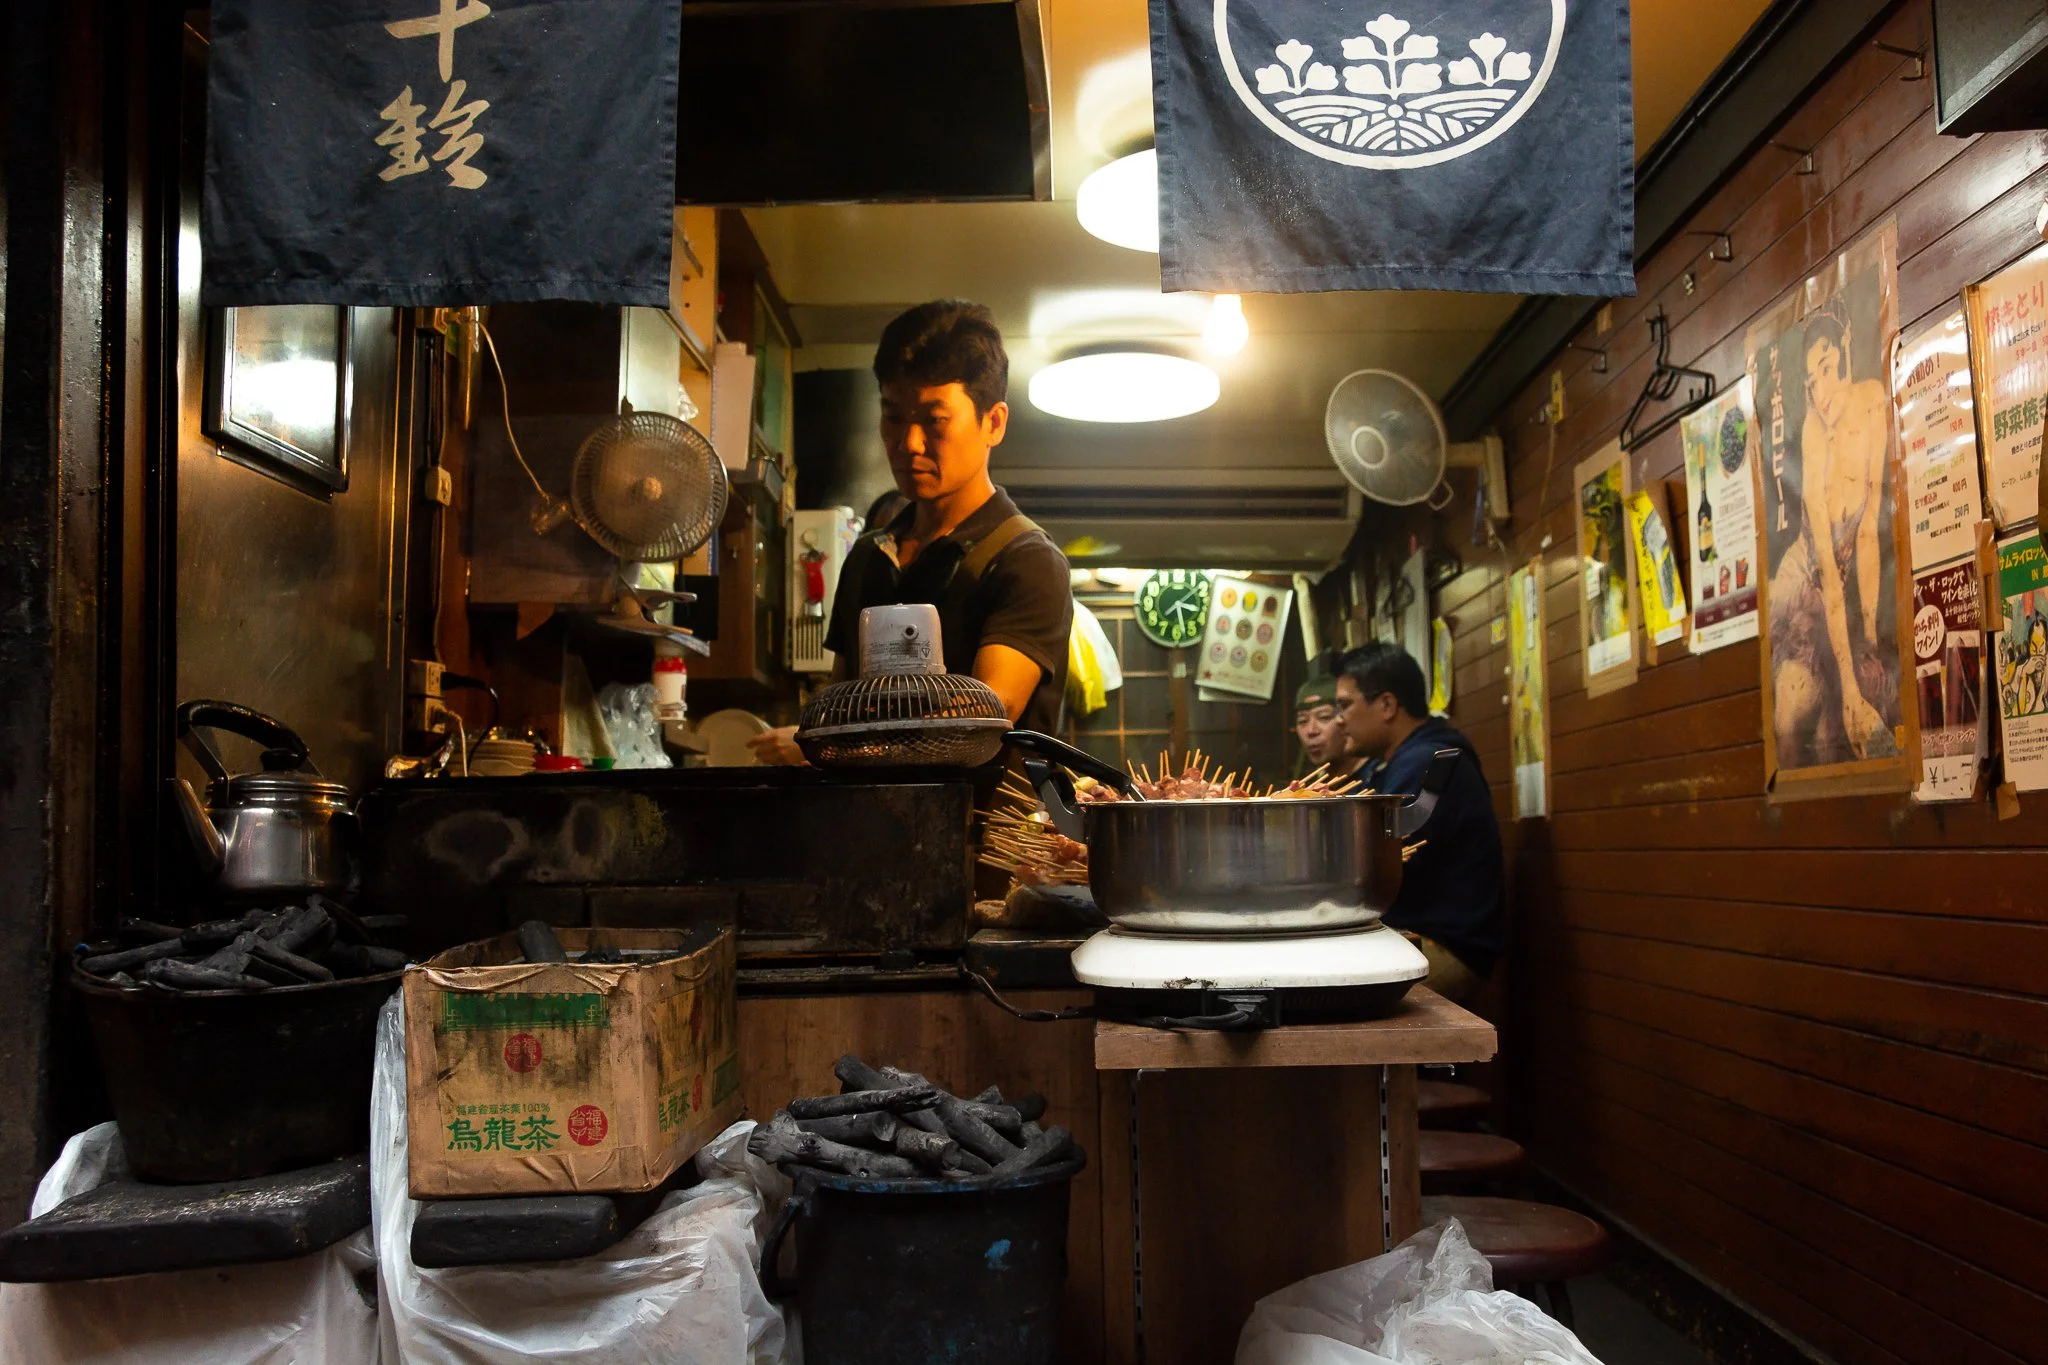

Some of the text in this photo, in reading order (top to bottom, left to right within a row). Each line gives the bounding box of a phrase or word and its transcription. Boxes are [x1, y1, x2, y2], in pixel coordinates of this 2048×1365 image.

[1985, 280, 2045, 337] 焼きとり
[1769, 343, 1788, 532] サッポロビール
[1159, 620, 1168, 637] 7
[447, 1114, 561, 1152] 烏龍茶
